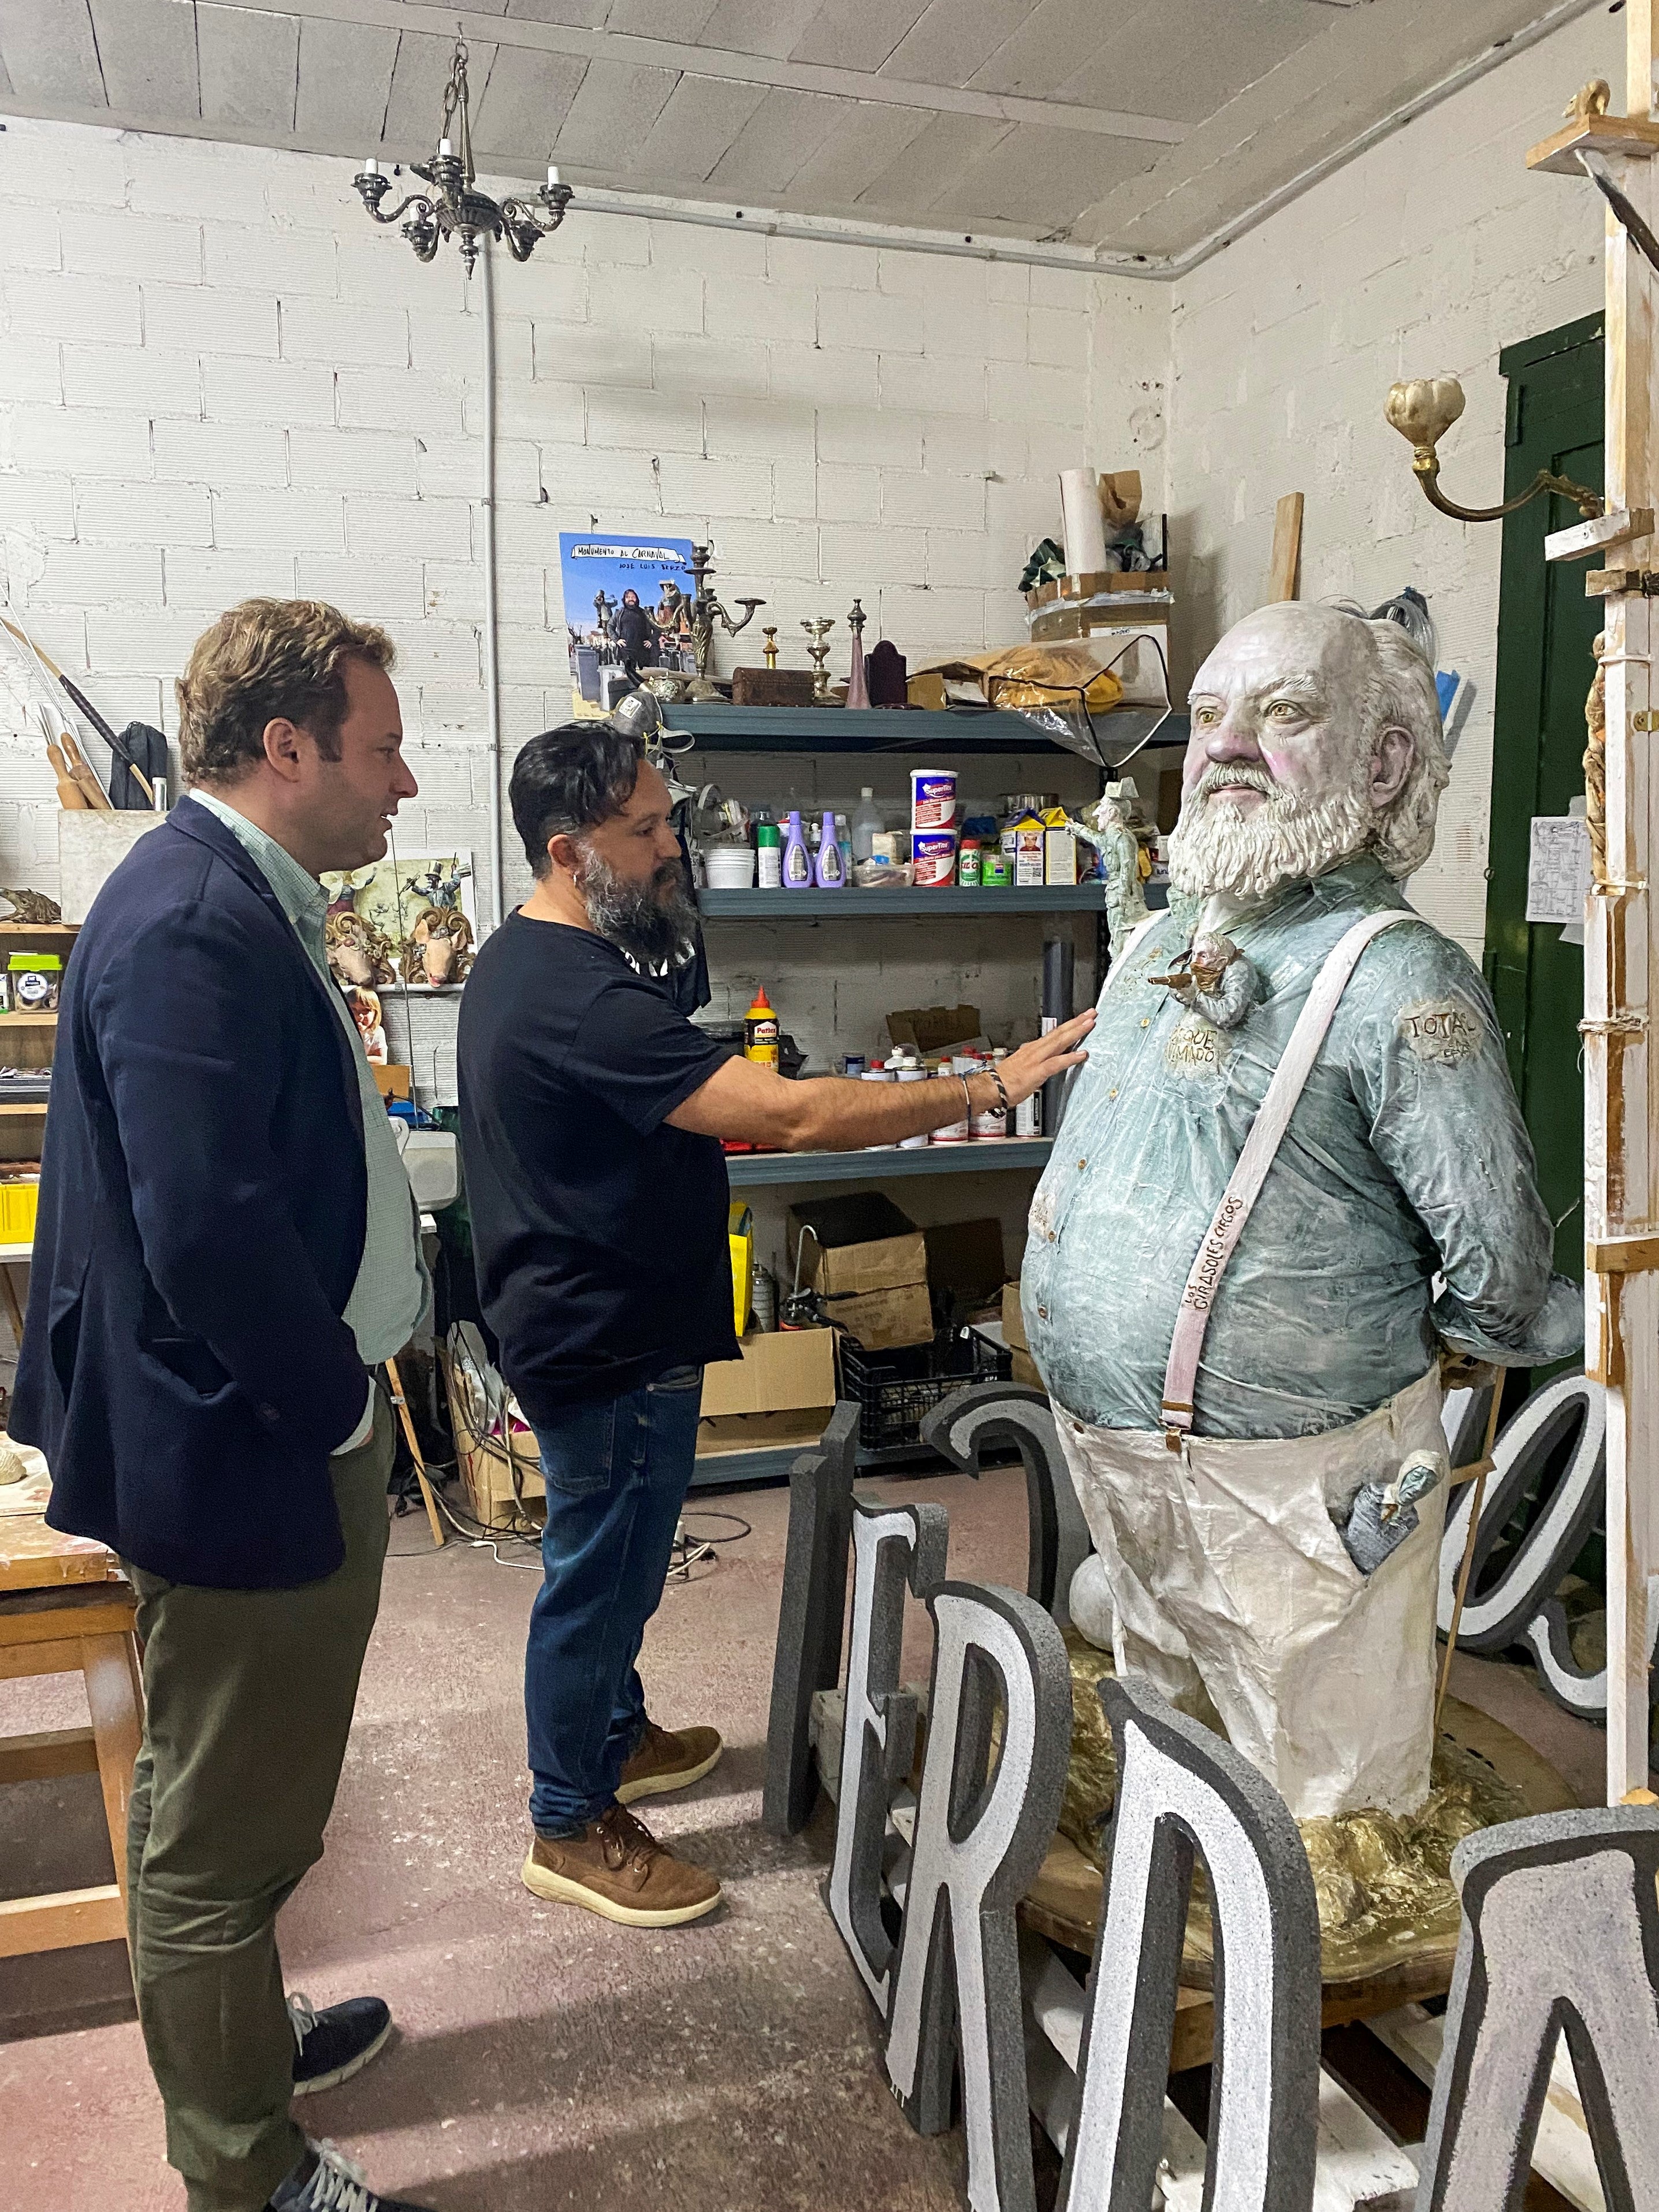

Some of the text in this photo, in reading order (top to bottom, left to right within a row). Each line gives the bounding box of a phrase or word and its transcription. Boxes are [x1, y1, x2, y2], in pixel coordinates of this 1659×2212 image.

[578, 547, 614, 556] MONUMENTO
[632, 548, 669, 560] CARNAVAL
[1193, 1196, 1244, 1310] GIRASOLES CIEGOS
